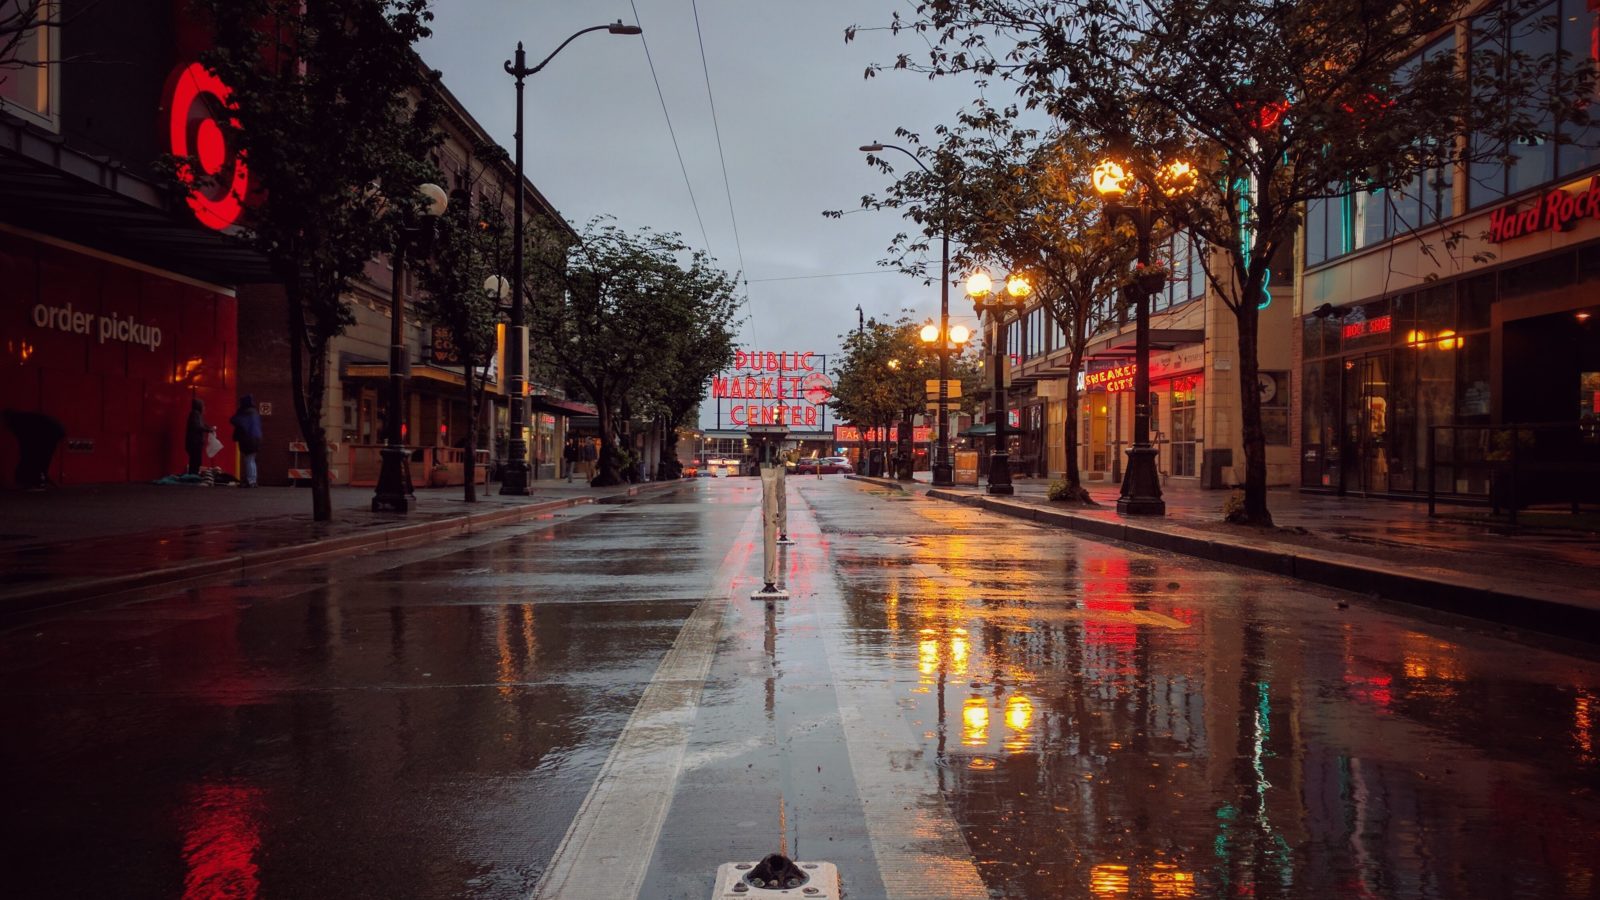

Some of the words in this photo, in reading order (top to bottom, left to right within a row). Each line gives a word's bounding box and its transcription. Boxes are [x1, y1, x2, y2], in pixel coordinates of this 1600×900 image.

[1488, 194, 1543, 244] Hard
[1544, 174, 1600, 233] Rock
[33, 302, 95, 336] order
[99, 311, 162, 352] pickup
[735, 351, 814, 371] PUBLIC
[712, 376, 802, 399] MARKET
[1106, 377, 1134, 392] CITY
[730, 405, 817, 425] CENTER
